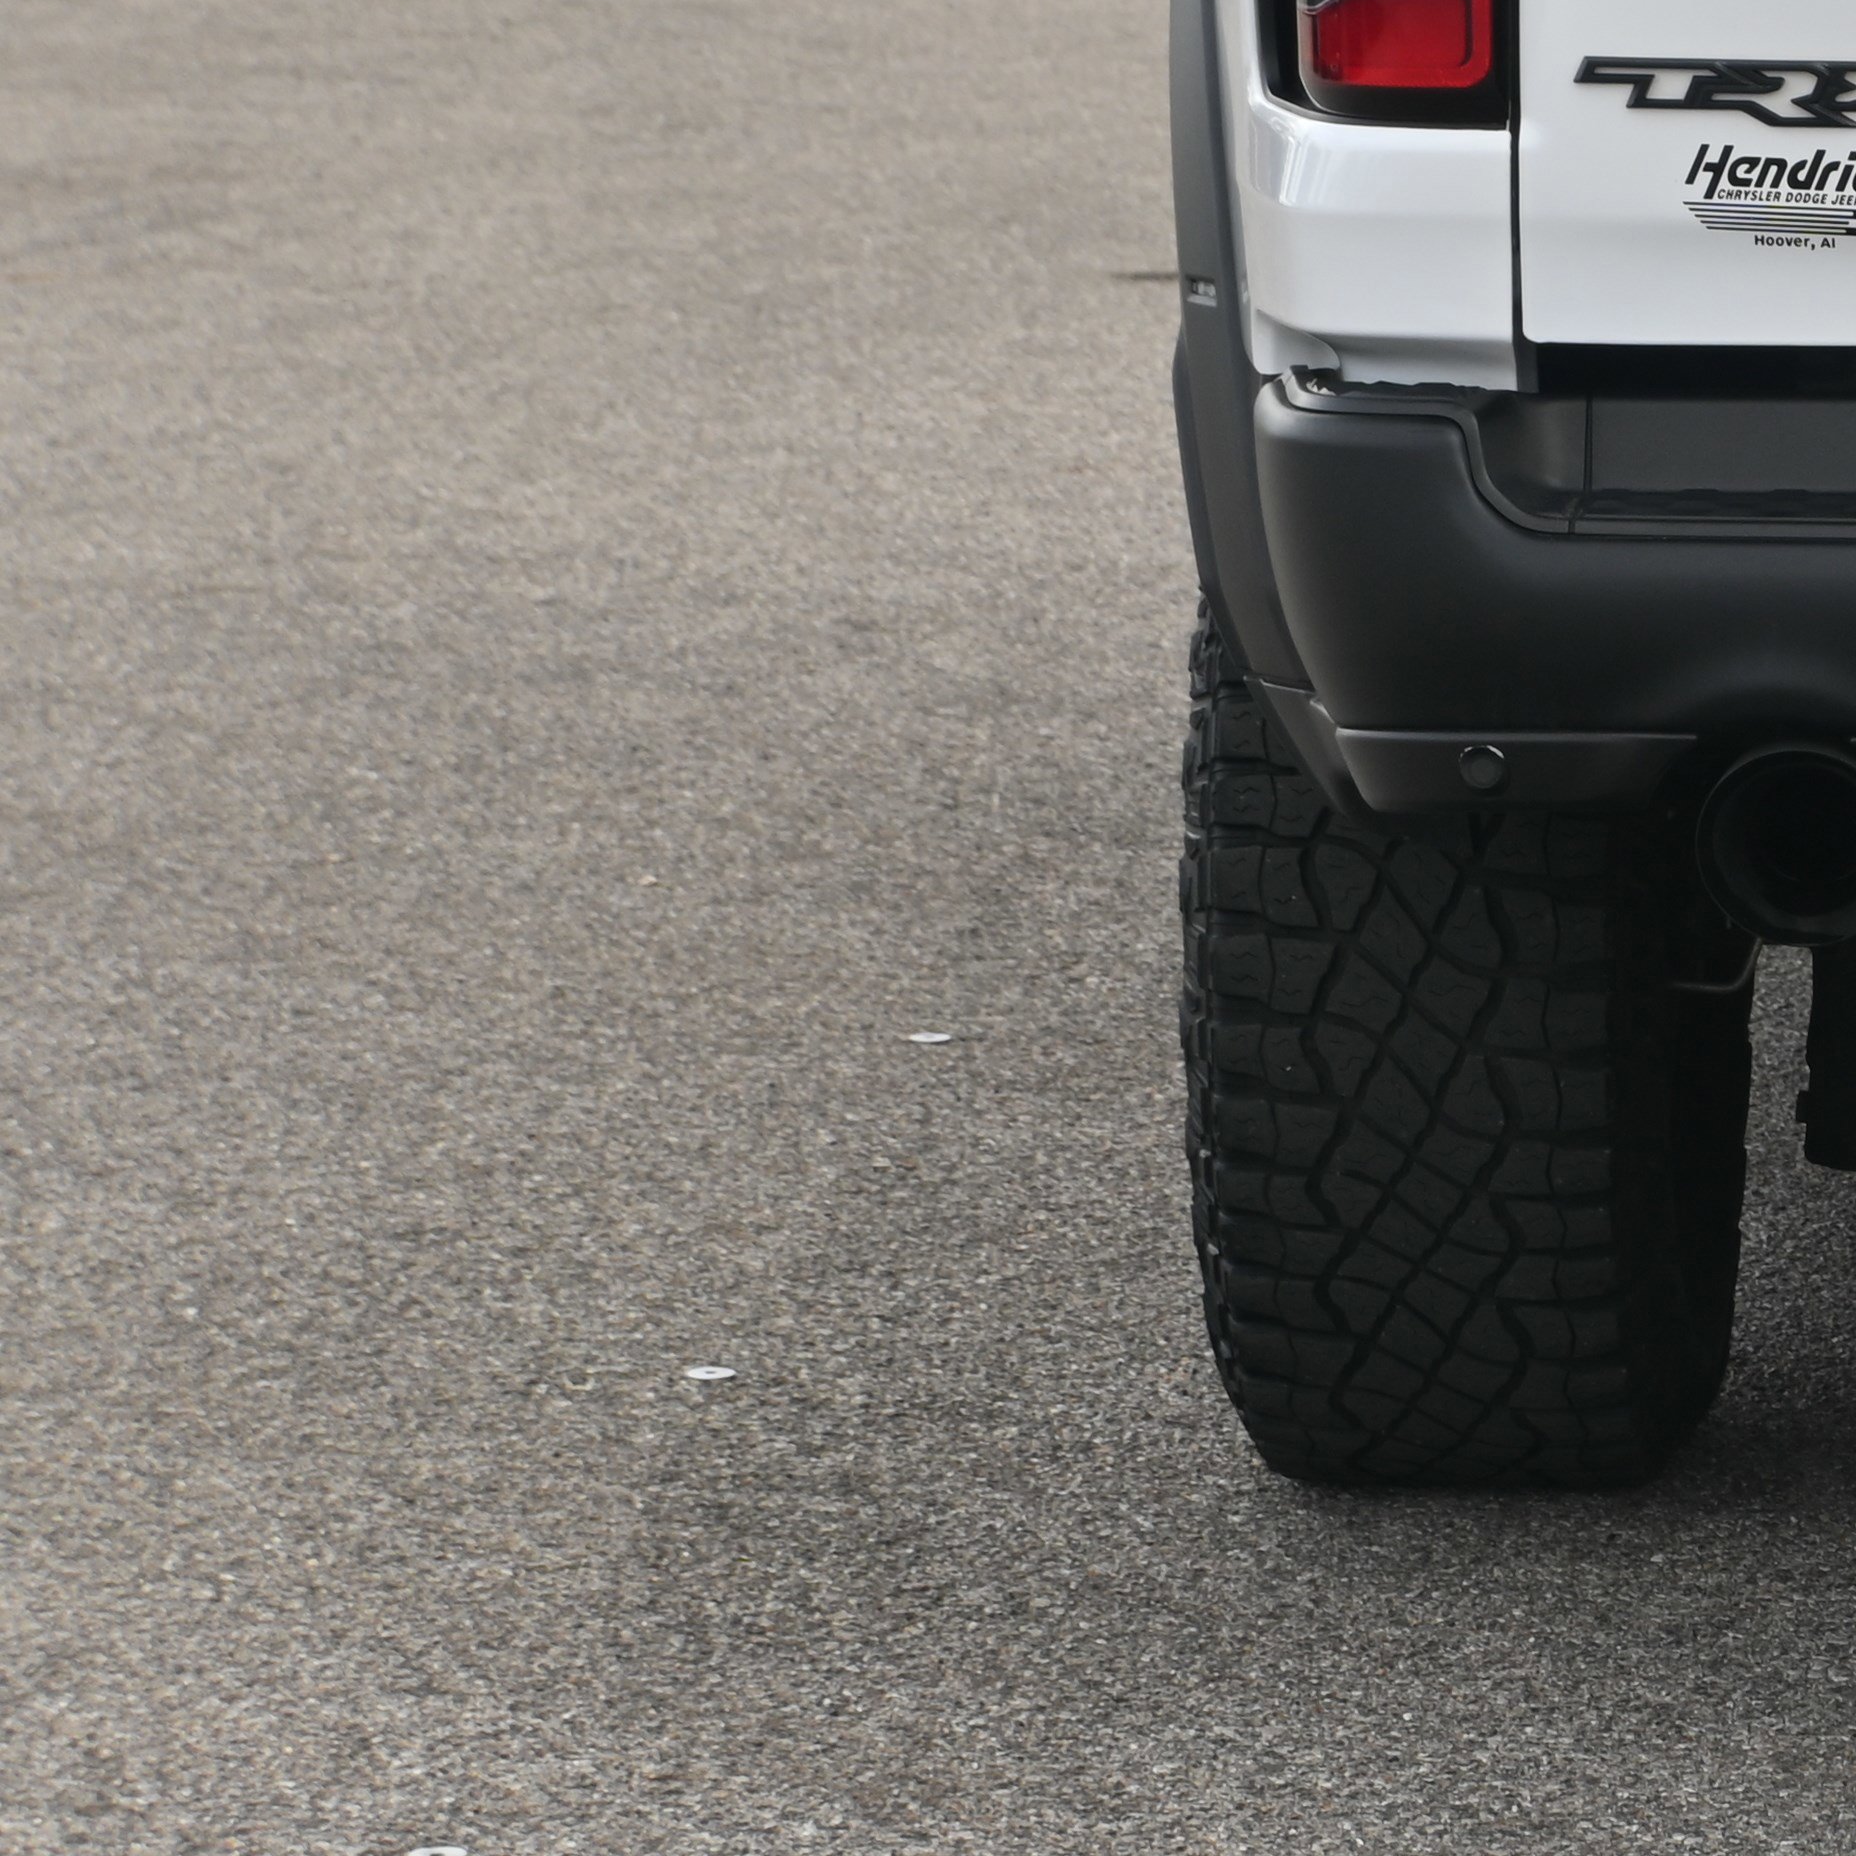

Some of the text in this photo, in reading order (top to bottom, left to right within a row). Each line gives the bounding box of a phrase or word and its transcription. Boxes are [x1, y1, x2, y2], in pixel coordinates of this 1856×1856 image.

[1717, 188, 1782, 203] CHRYSLER
[1785, 192, 1828, 205] DODGE
[1754, 234, 1816, 250] Hoover,
